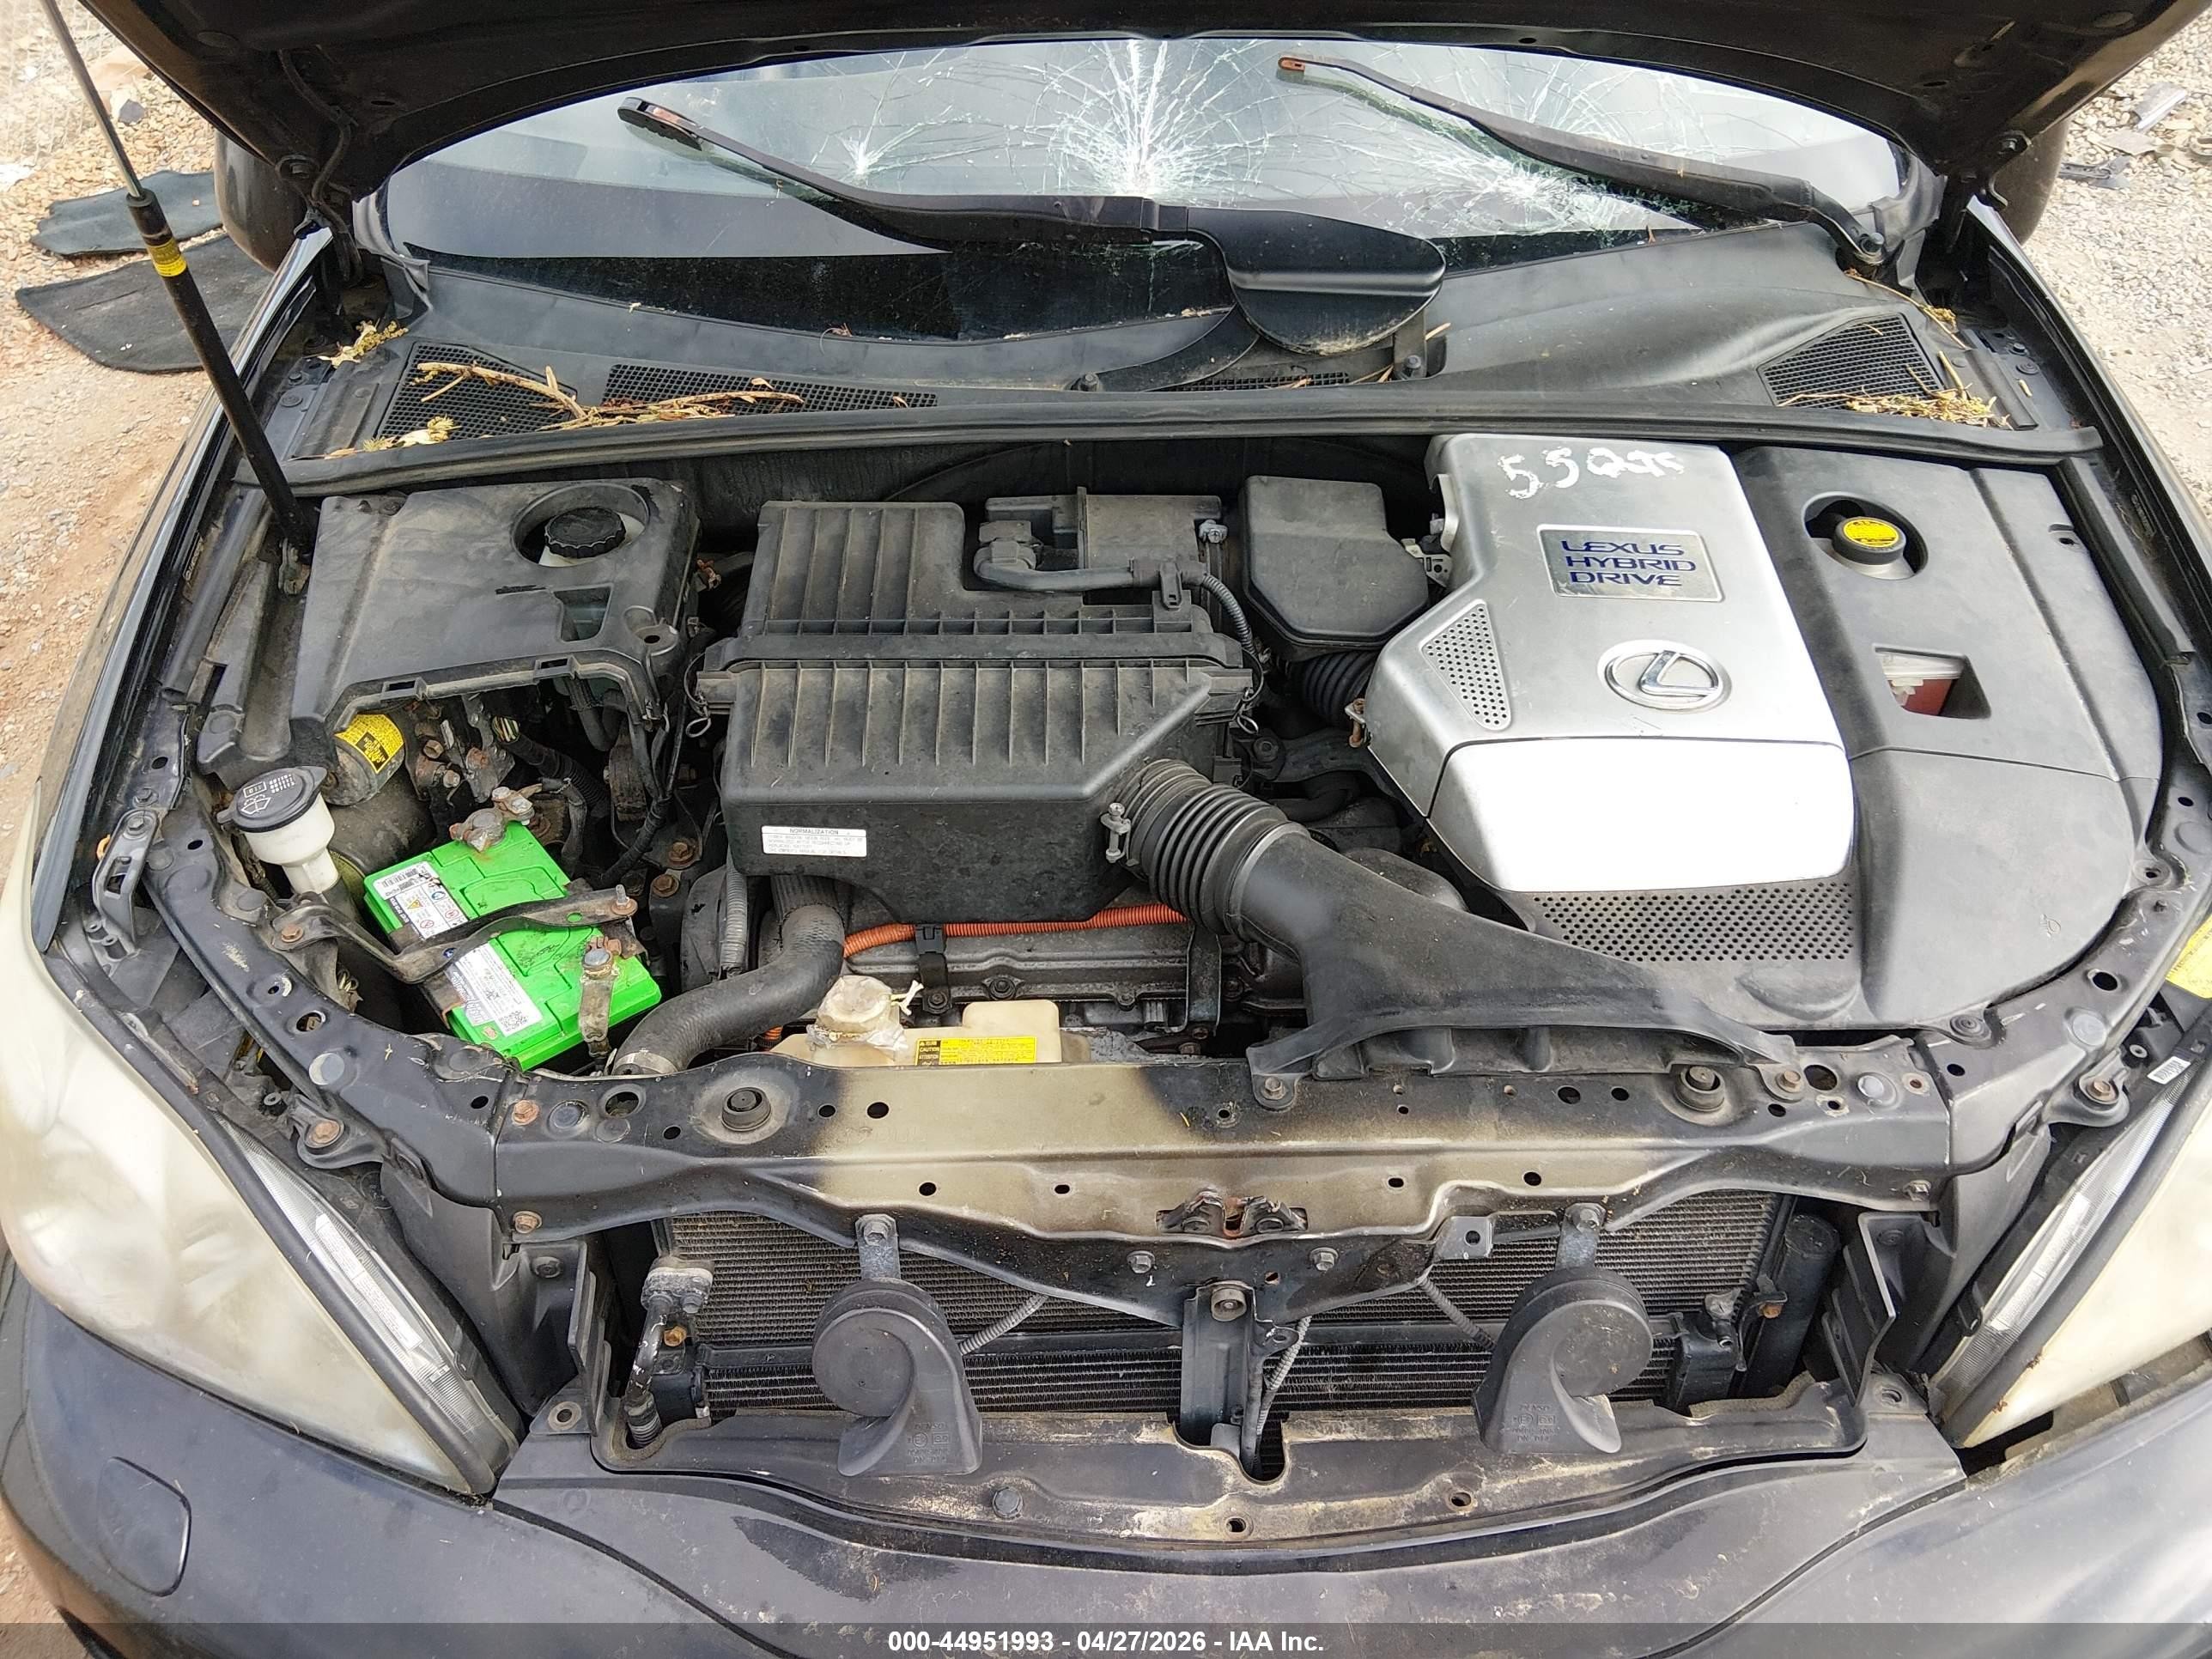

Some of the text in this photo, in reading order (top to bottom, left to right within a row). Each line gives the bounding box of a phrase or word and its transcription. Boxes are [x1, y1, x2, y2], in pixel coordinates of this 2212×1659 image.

[1561, 540, 1685, 556] LEXUS
[1565, 556, 1696, 572] HYBRID
[1570, 571, 1683, 586] DRIVE
